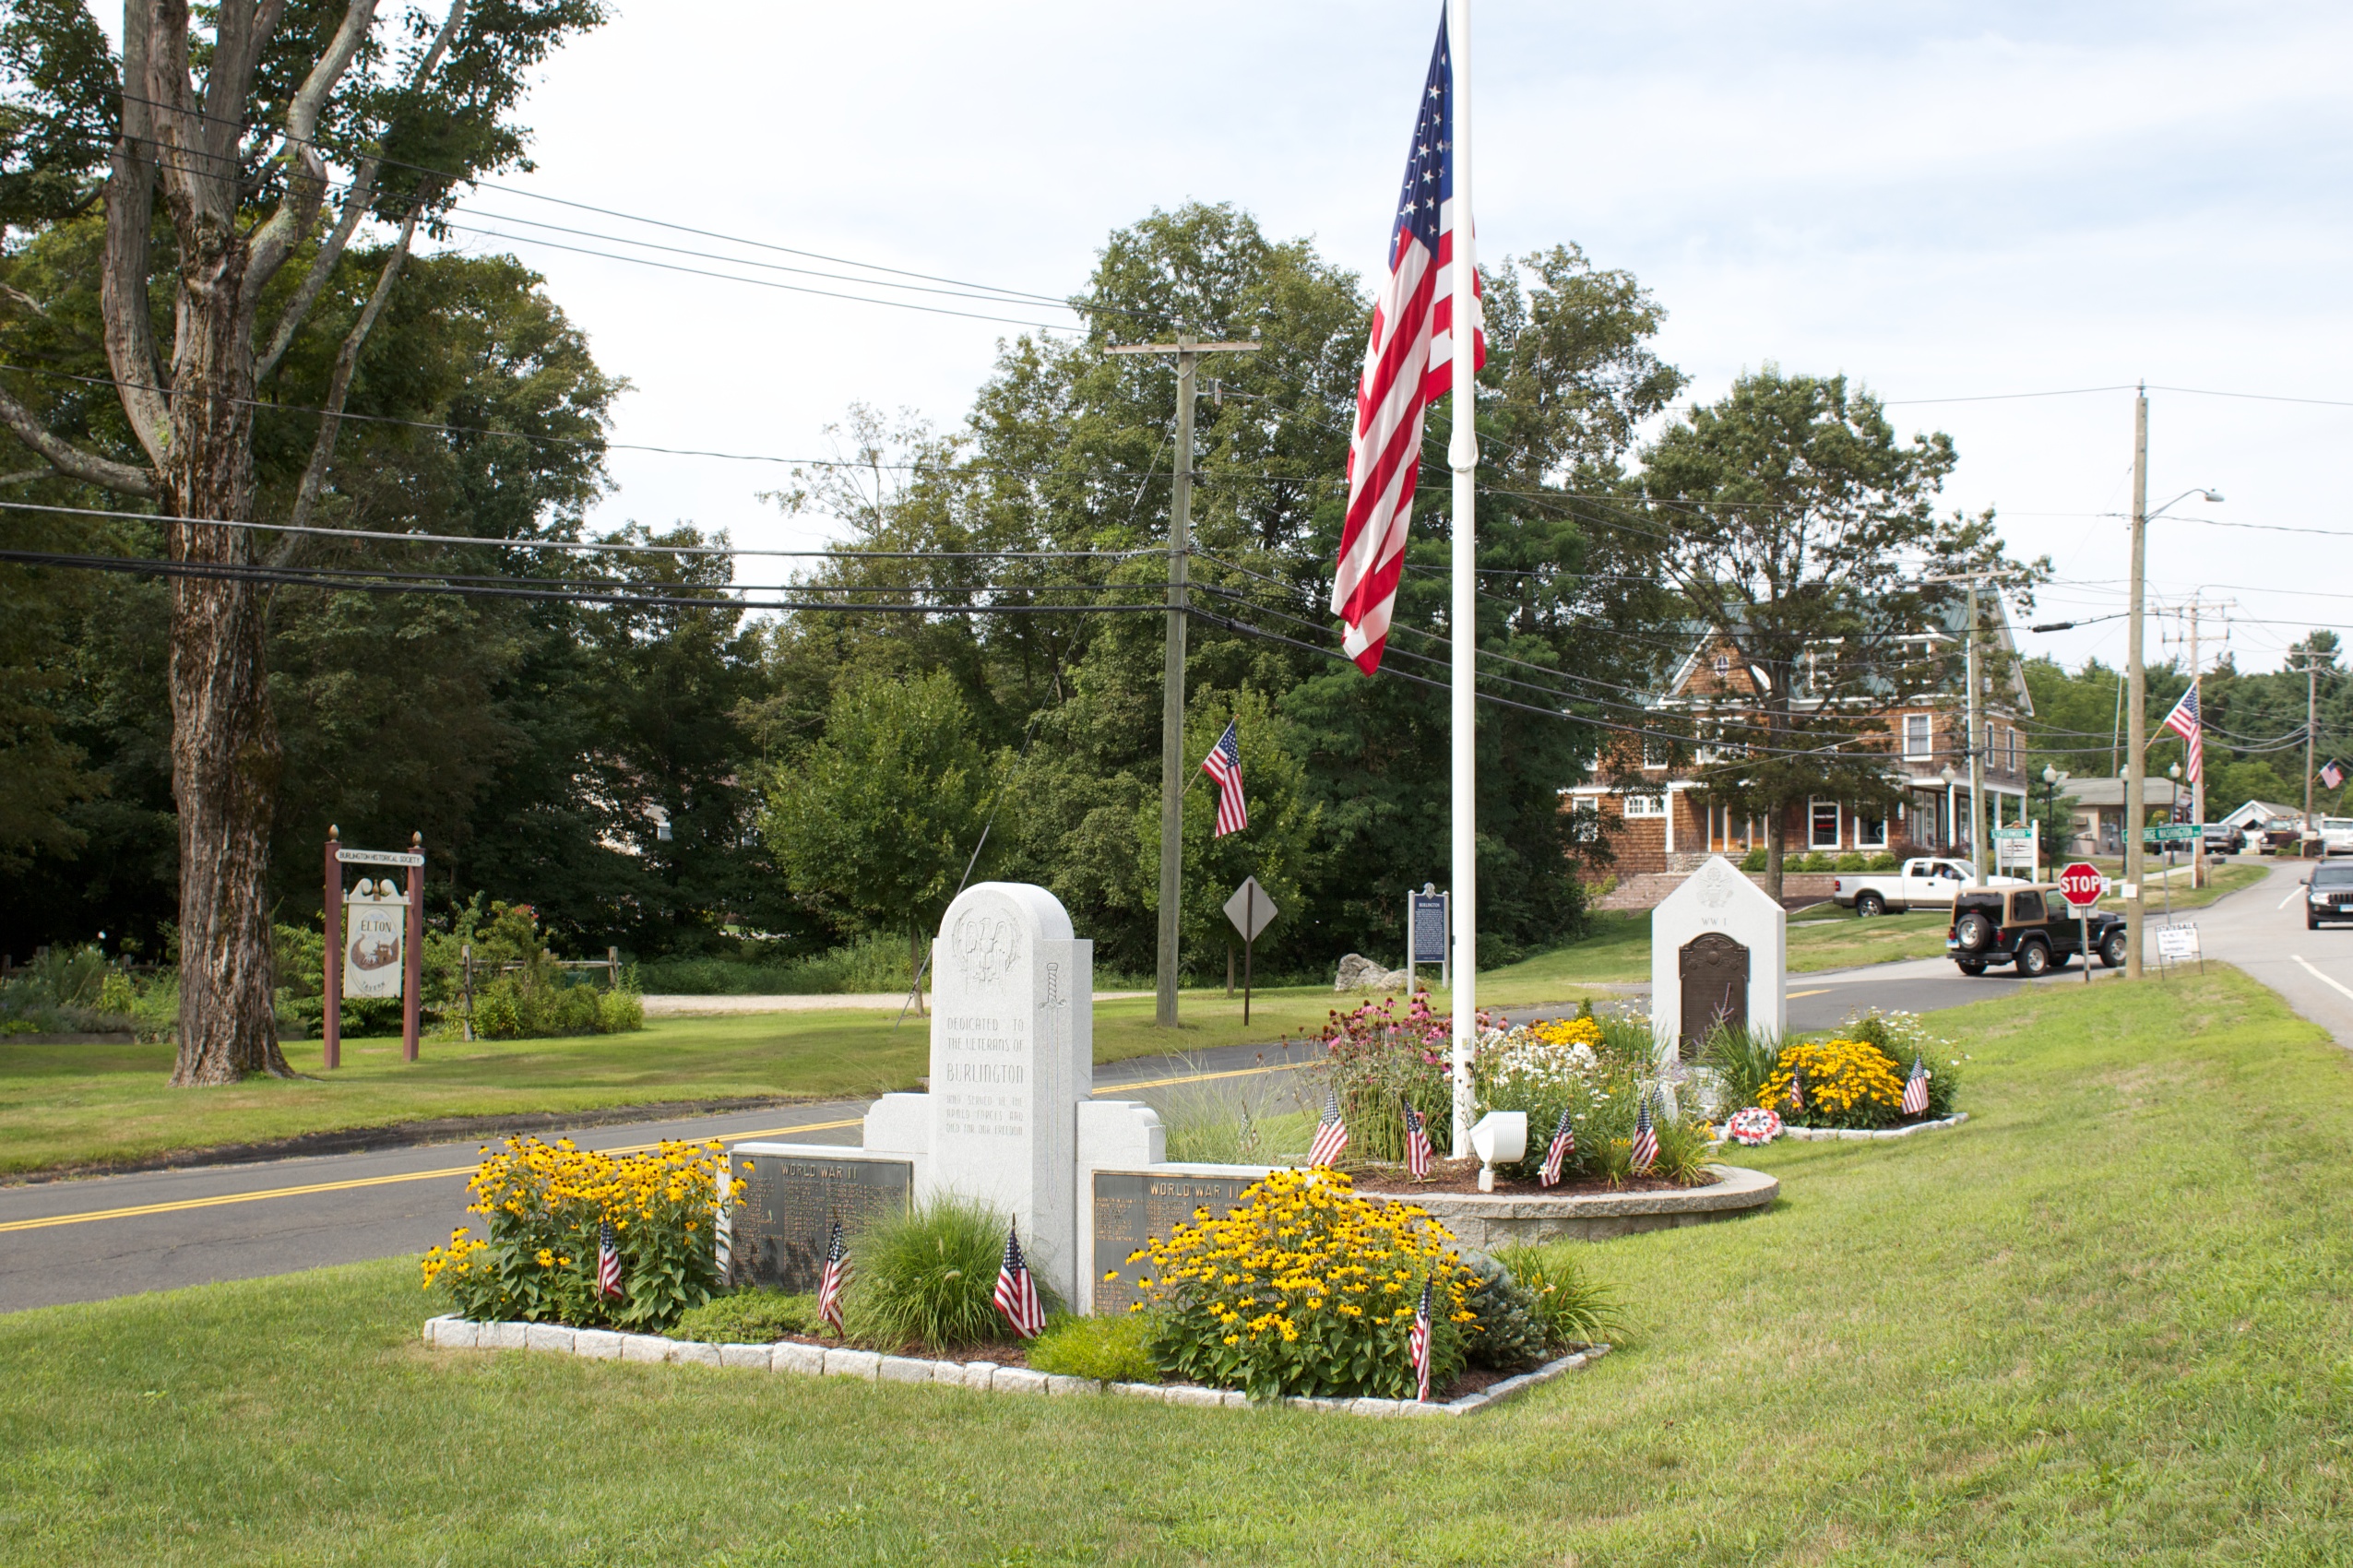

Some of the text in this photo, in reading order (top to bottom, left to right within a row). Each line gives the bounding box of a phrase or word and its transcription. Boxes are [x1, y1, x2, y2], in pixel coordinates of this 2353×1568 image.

[2158, 827, 2193, 839] WASHINGTON
[339, 851, 421, 864] BURLINGTON HISTORICAL SOCIETY
[2061, 875, 2100, 893] STOP
[361, 921, 391, 932] ELTON
[1701, 917, 1718, 926] WW
[363, 980, 386, 992] TAVERN
[947, 1017, 1024, 1032] DEDICATED TO
[948, 1037, 1025, 1051] THE VETERANS OF
[946, 1063, 1024, 1084] BURLINGTON
[968, 1094, 992, 1106] SERVED
[1012, 1096, 1023, 1107] THE
[946, 1108, 1024, 1122] ARMED FORCES AND
[978, 1123, 991, 1134] OUR
[994, 1124, 1023, 1136] FREEDOM
[781, 1162, 858, 1180] WORLD WAR II
[1150, 1182, 1240, 1199] WORLD WAR II
